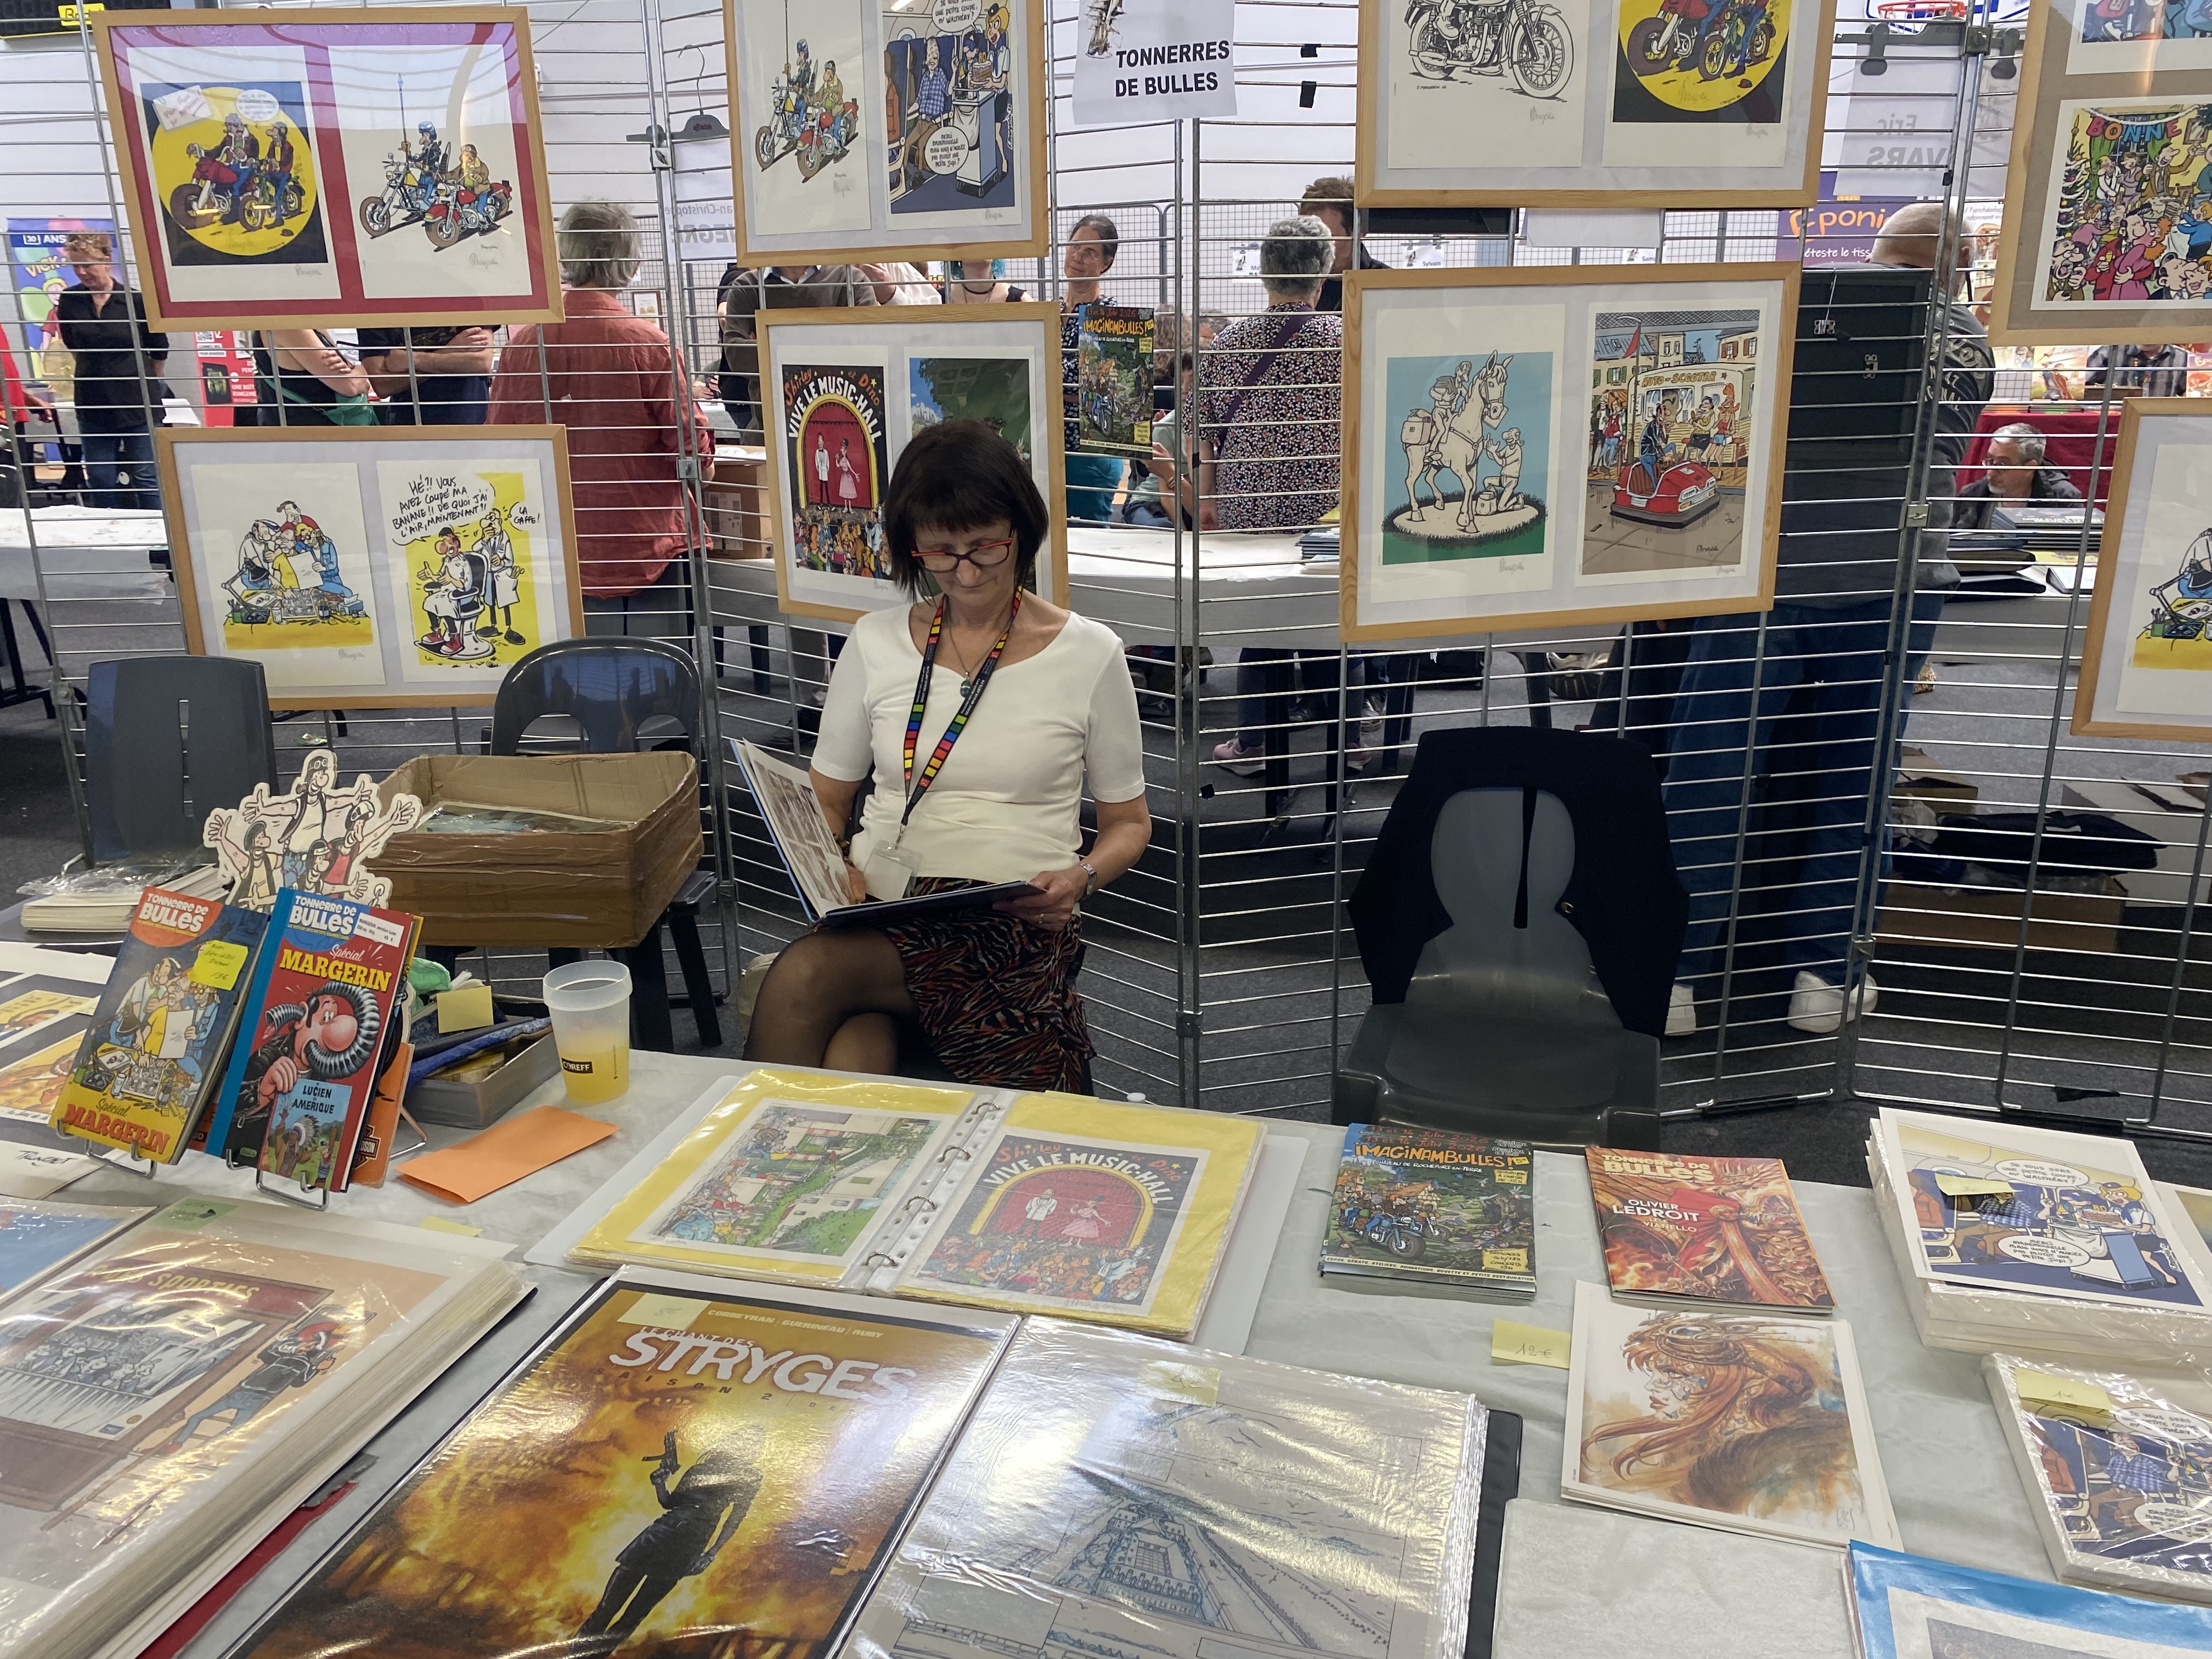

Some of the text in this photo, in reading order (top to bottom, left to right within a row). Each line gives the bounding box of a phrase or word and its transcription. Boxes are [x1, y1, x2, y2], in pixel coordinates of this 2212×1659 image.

[978, 52, 986, 63] 80
[1115, 40, 1230, 69] TONNERRES
[1115, 71, 1218, 97] DE BULLES
[2086, 116, 2182, 142] BONNE
[1789, 207, 1890, 242] Eponi
[43, 235, 66, 243] ANS
[1804, 247, 1838, 257] éteste
[1841, 247, 1849, 257] le
[1120, 309, 1136, 317] 2026
[785, 368, 812, 405] Shirley
[858, 373, 880, 406] Dino
[788, 376, 882, 443] VIVE LE MUSIC-HALL
[399, 498, 421, 514] AVEZ
[453, 487, 467, 497] MA
[438, 500, 449, 512] DE
[452, 496, 470, 511] QUOI
[330, 944, 365, 962] Spécial
[279, 949, 392, 992] MARGERIN
[303, 1085, 332, 1098] LUCIEN
[95, 1098, 131, 1116] Spécial
[292, 1099, 335, 1114] AMERIQUE
[62, 1103, 171, 1155] MARGERIN
[1448, 1144, 1486, 1152] 2026
[1451, 1135, 1489, 1144] 2026
[996, 1144, 1061, 1163] Shirley
[1147, 1159, 1181, 1182] Dino
[984, 1153, 1173, 1204] VIVE LE MUSIC-HALL
[1612, 1205, 1699, 1222] LEDROIT
[1628, 1199, 1679, 1210] OLIVIER
[1643, 1221, 1697, 1232] VIANELLO
[707, 1309, 884, 1339] CORBEYRAN GUERINEAU RUBY
[640, 1326, 755, 1349] LE CHANT DES
[609, 1330, 918, 1406] STRYGES
[760, 1392, 774, 1401] 2
